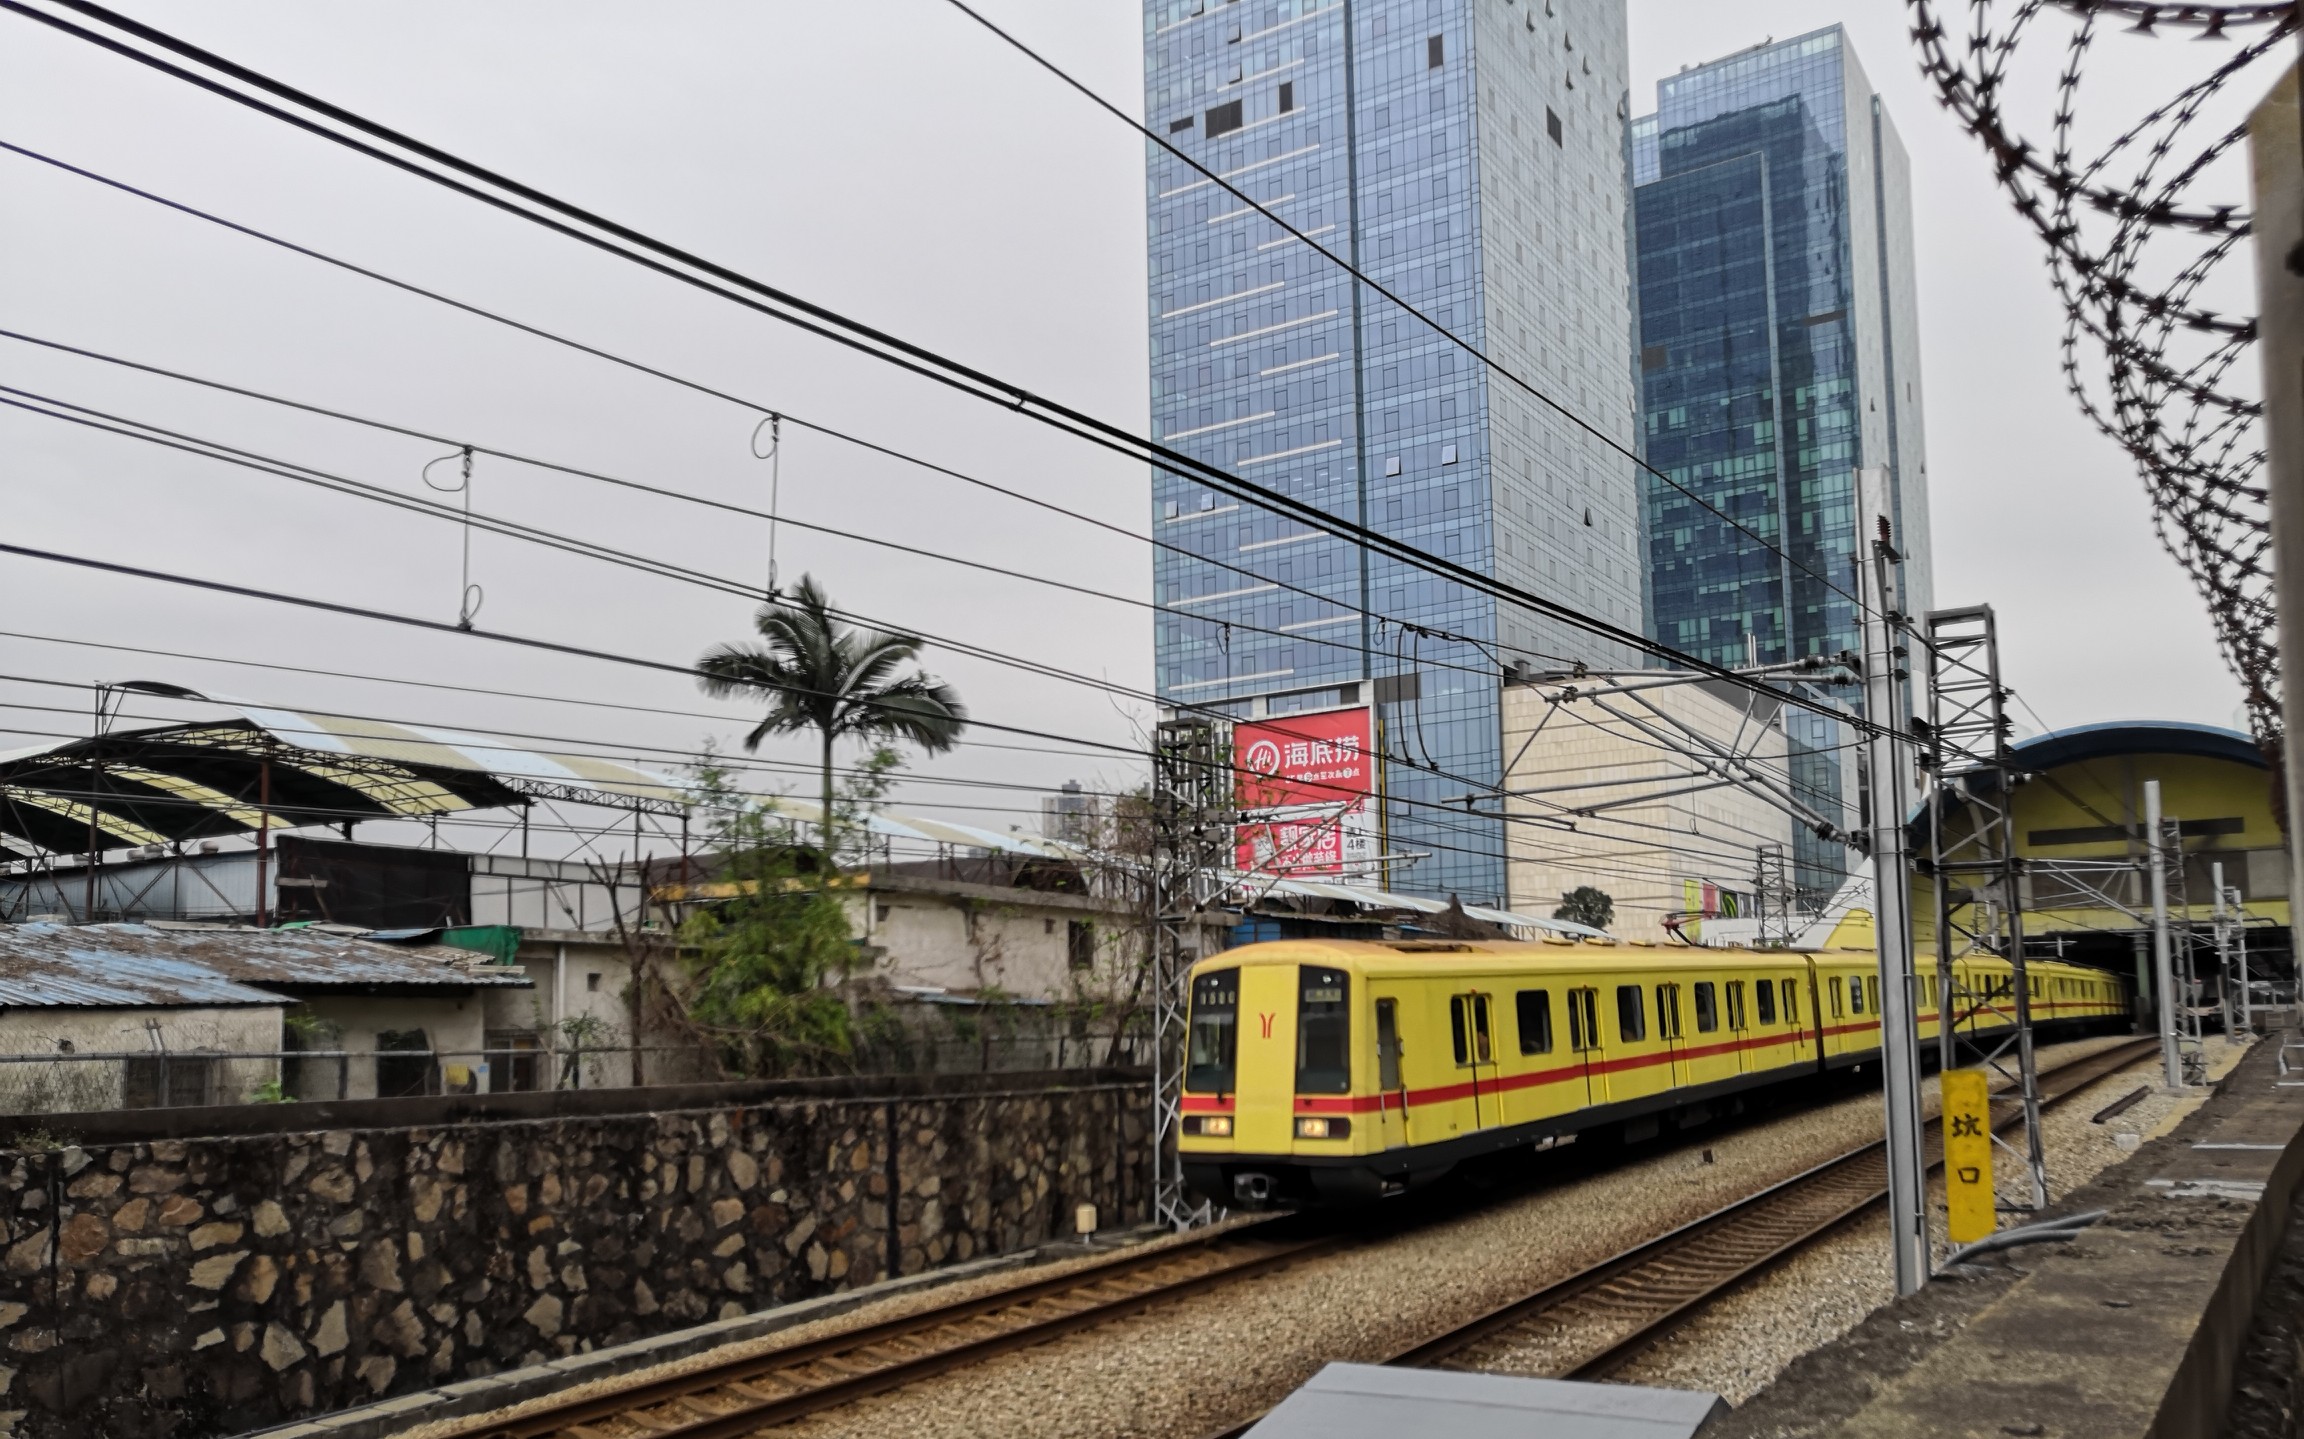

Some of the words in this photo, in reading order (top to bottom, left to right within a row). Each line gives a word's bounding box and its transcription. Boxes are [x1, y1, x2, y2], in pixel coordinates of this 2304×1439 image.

[1284, 736, 1359, 768] 海底捞
[1951, 1114, 1982, 1183] 坑口
